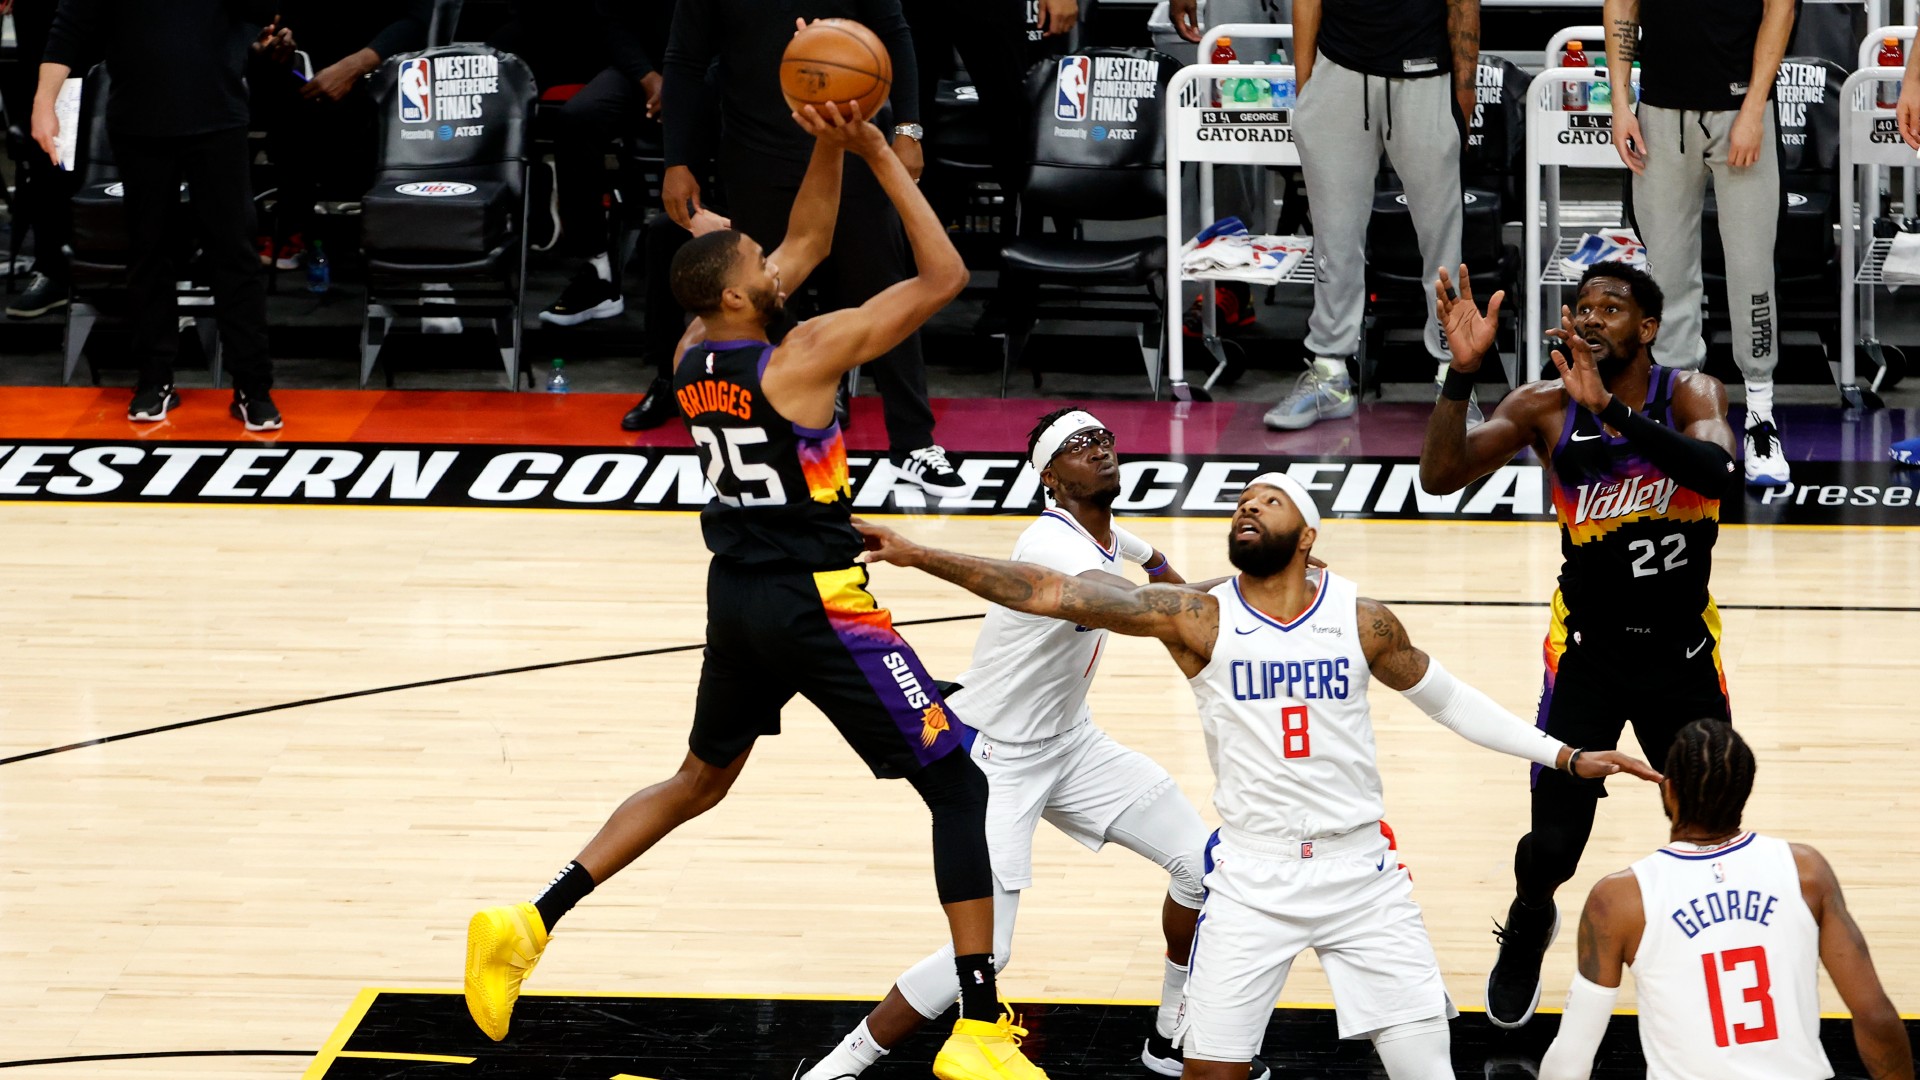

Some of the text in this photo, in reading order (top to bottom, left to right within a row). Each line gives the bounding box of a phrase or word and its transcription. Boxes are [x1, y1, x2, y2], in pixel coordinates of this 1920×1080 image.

[434, 55, 498, 80] WESTERN
[1094, 57, 1159, 81] WESTERN
[435, 77, 498, 97] CONFERENCE
[1093, 79, 1156, 98] CONFERENCE
[435, 95, 482, 121] FINALS
[1091, 97, 1138, 122] FINALS
[1203, 112, 1217, 123] 13
[1239, 112, 1279, 122] GEORGE
[454, 125, 484, 137] AT&T
[1107, 128, 1137, 140] AT&T
[676, 379, 753, 421] BRIDGES
[0, 444, 460, 500] ESTERN
[1761, 481, 1920, 507] Prese
[691, 425, 788, 508] 25
[1574, 474, 1679, 526] Valley
[1601, 483, 1621, 495] THE
[1628, 532, 1688, 579] 22
[1229, 656, 1350, 701] CLIPPERS
[1281, 705, 1311, 759] 8
[1671, 889, 1779, 940] GEORGE
[1701, 945, 1779, 1048] 13
